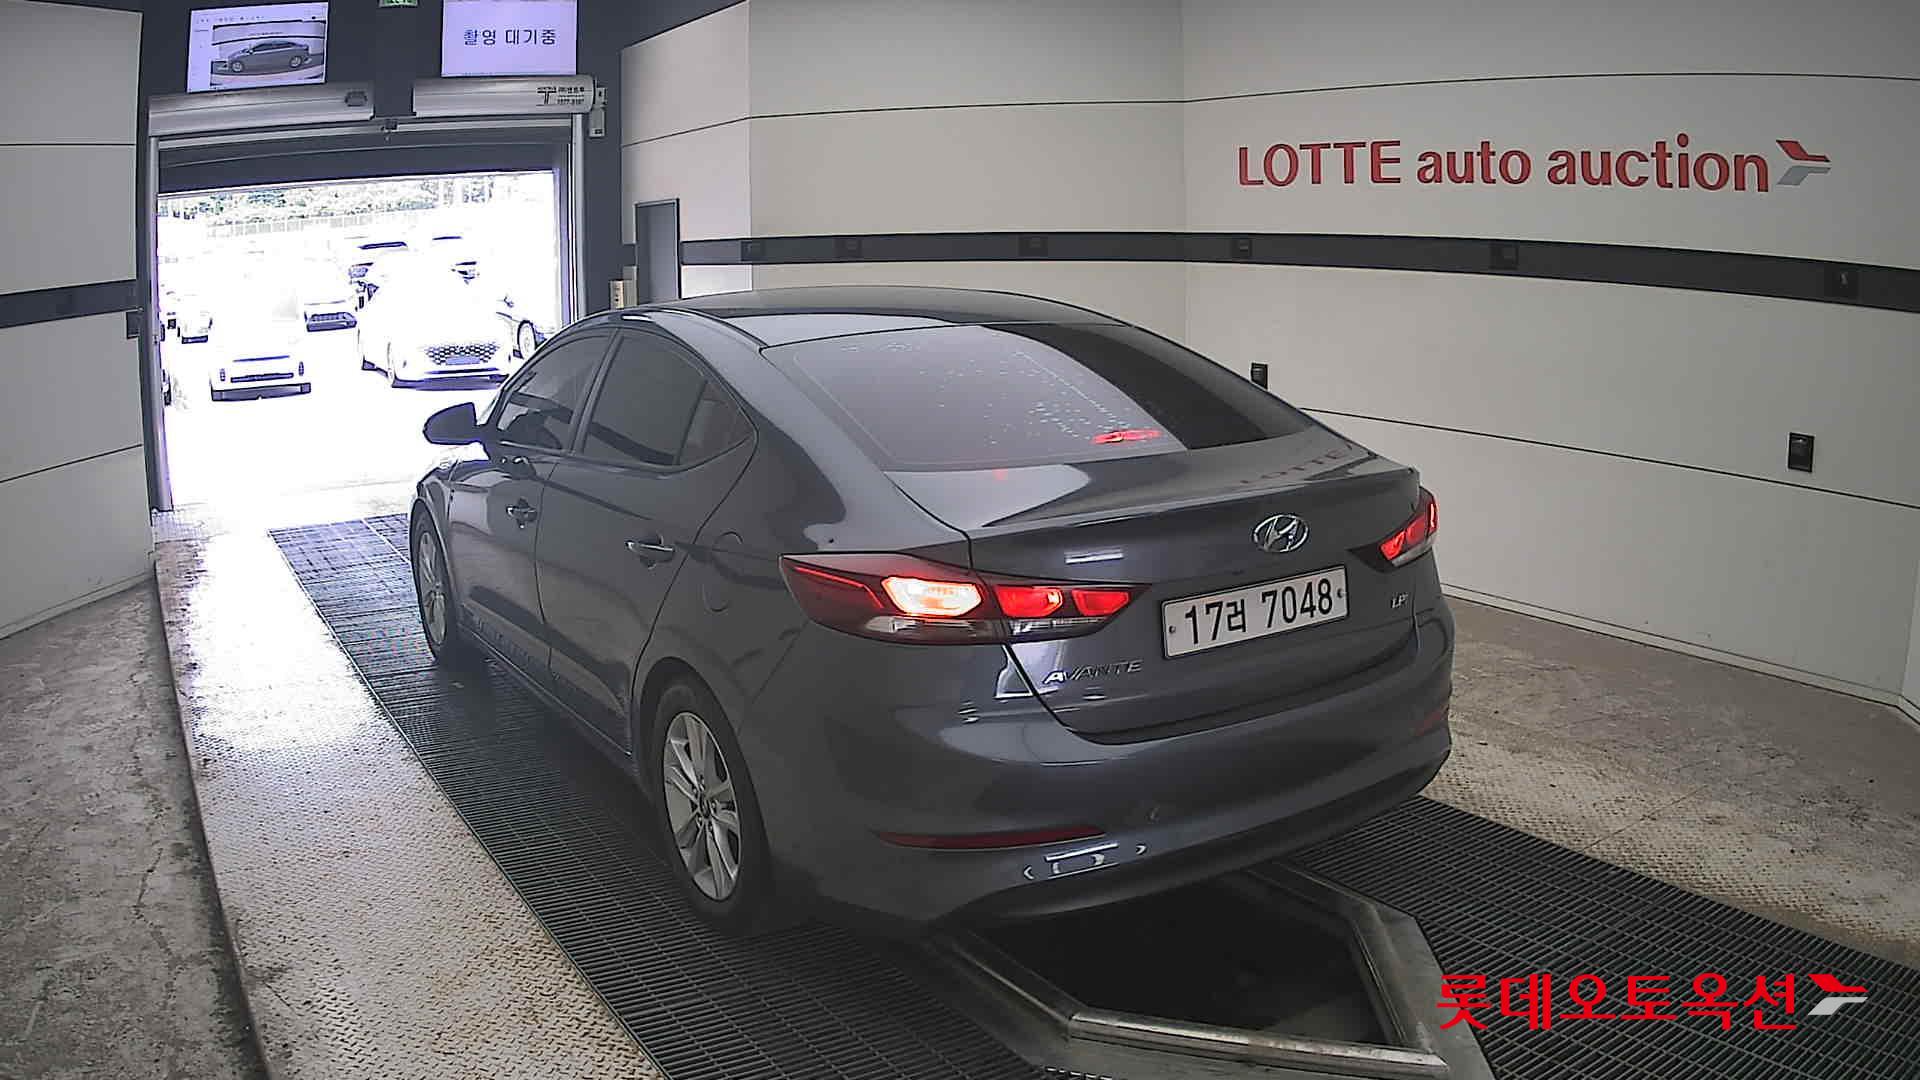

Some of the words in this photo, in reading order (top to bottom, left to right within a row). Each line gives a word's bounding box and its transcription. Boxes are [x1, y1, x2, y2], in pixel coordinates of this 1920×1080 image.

[505, 29, 557, 46] 대기중
[1238, 139, 1402, 186] LOTTE
[1416, 140, 1532, 185] auto
[1547, 132, 1769, 193] auction
[1184, 599, 1247, 645] 17러
[1260, 578, 1333, 629] 7048
[1042, 658, 1144, 685] AVANTE
